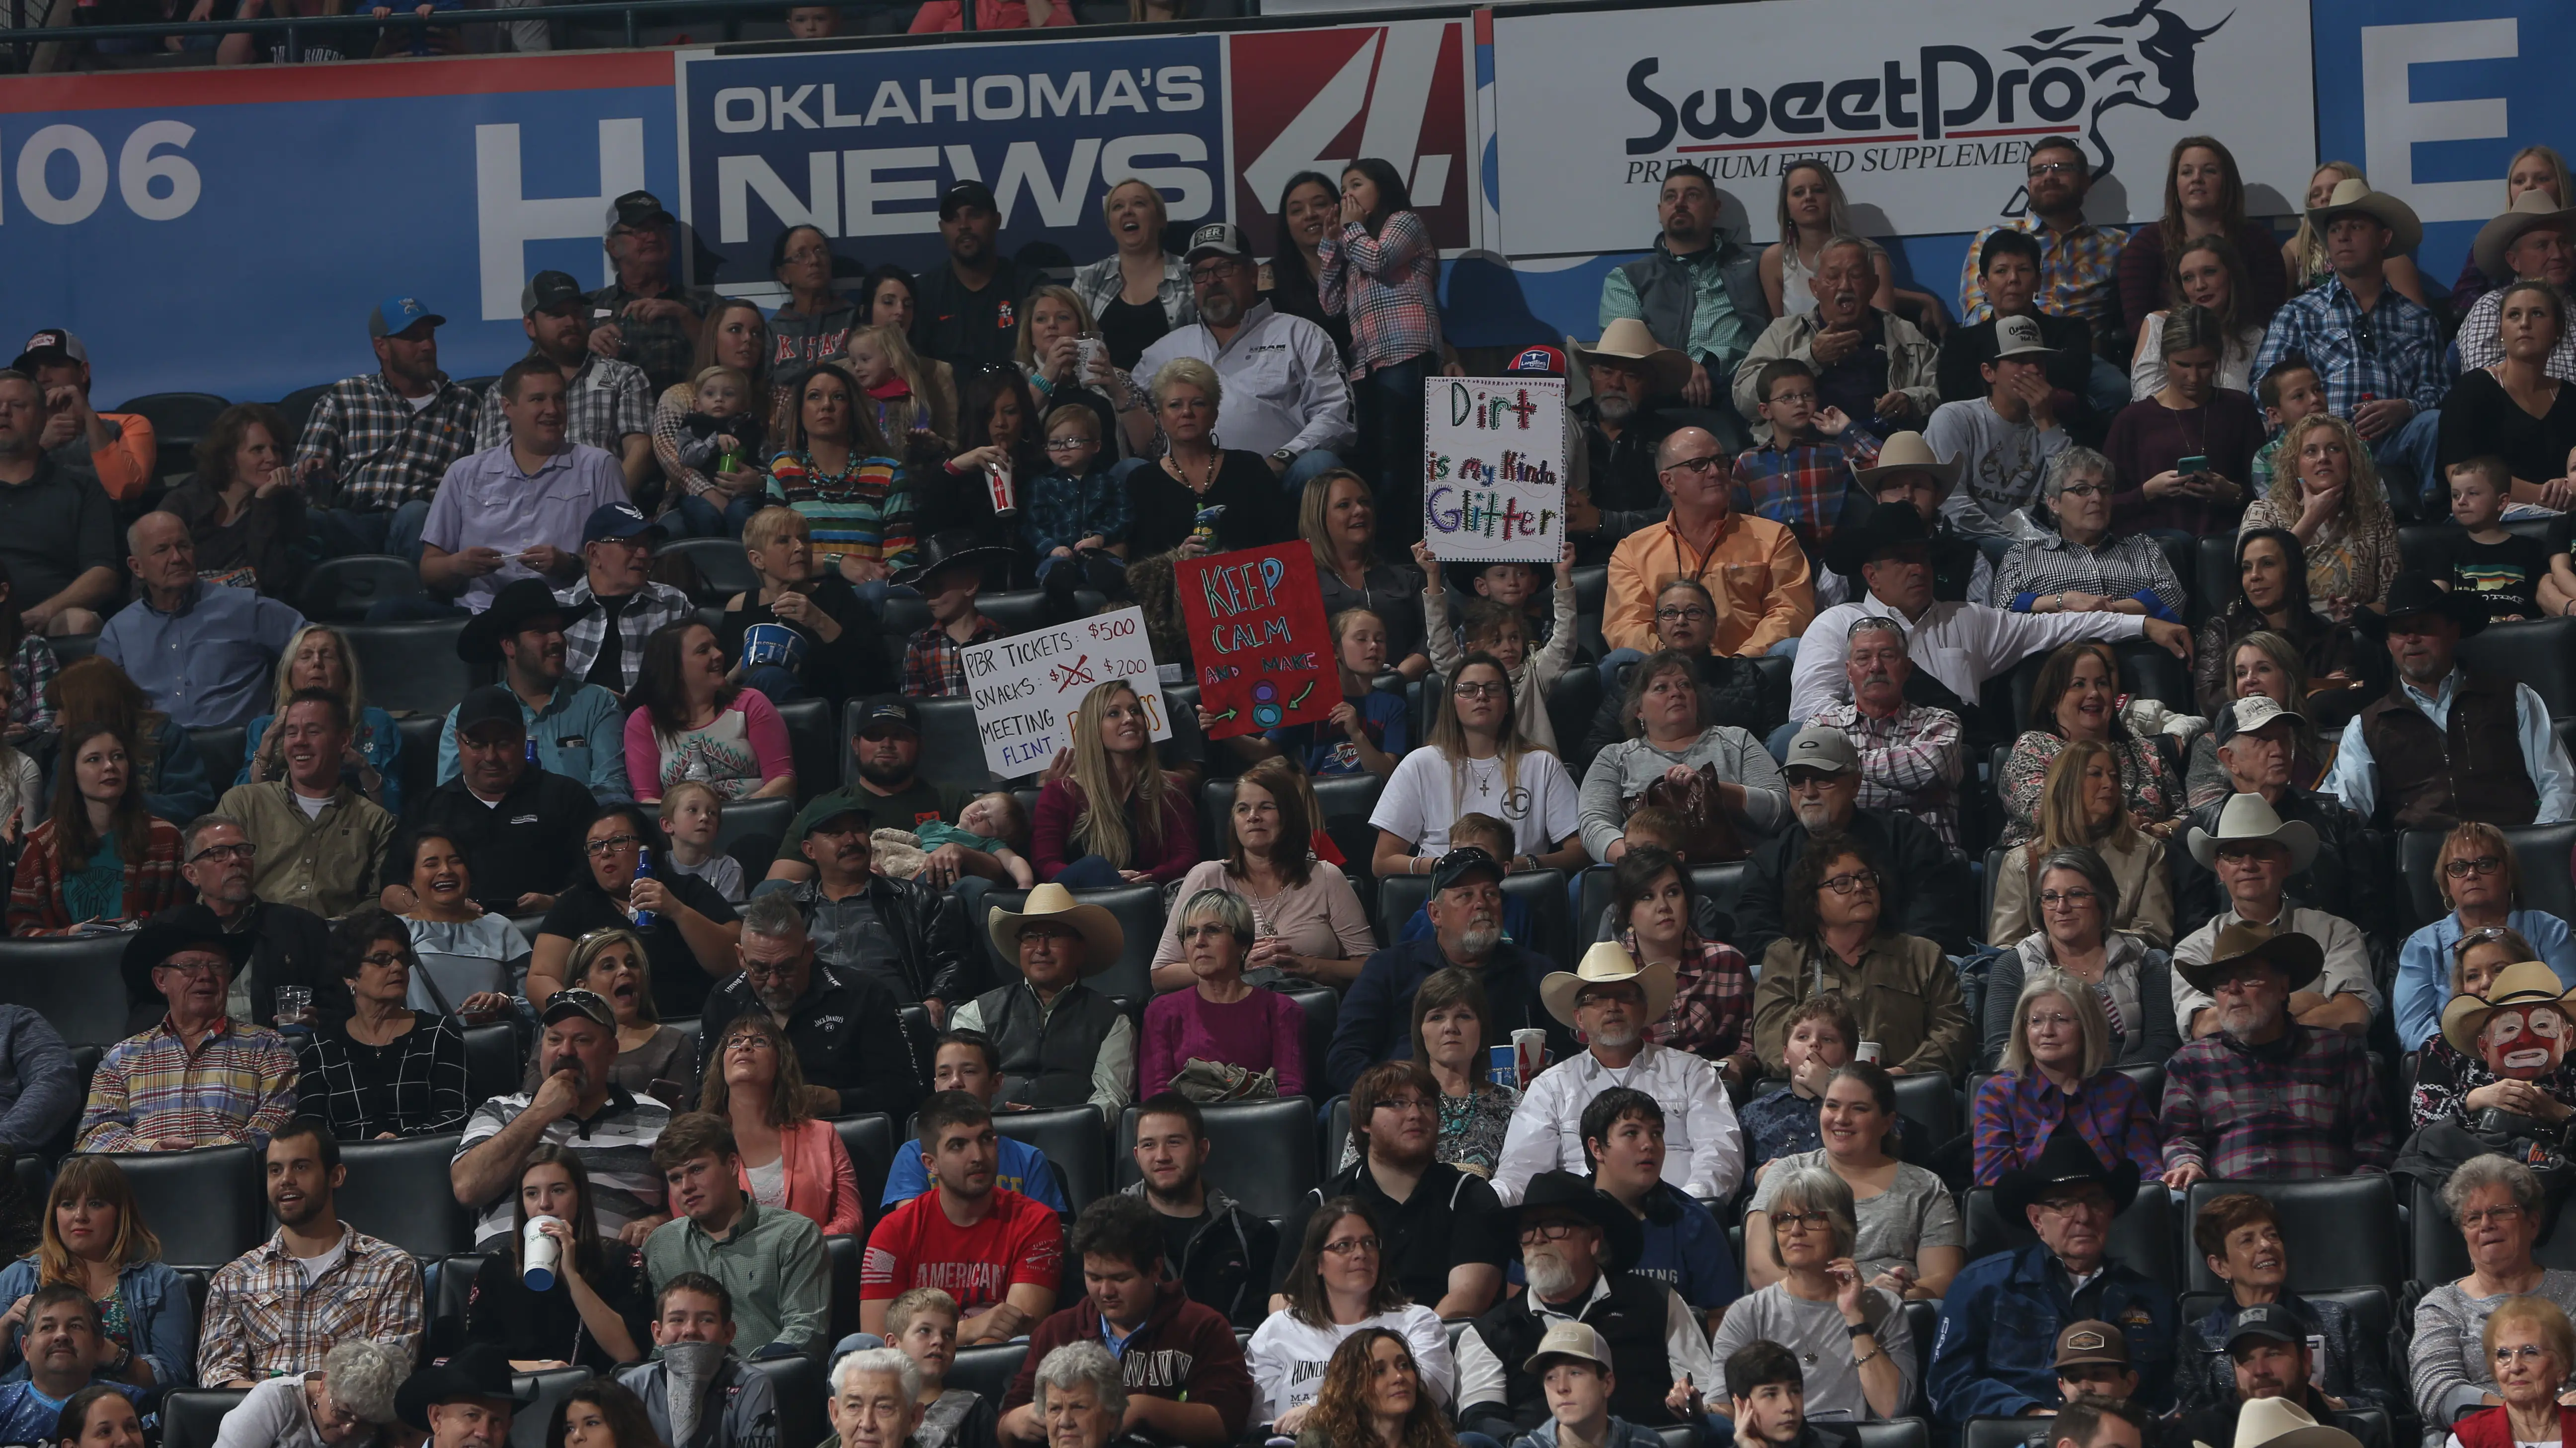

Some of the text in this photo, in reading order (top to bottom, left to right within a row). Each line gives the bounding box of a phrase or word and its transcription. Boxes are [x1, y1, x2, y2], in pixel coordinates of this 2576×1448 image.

[715, 66, 1205, 134] OKLAHOMA'S
[1626, 45, 2085, 155] SweetPro
[0, 120, 201, 226] 06
[718, 133, 1213, 243] NEWS
[1451, 382, 1537, 430] Dirt
[1429, 449, 1557, 487] is my Kinda
[1428, 484, 1557, 541] Glitter
[1201, 558, 1284, 618] KEEP
[966, 649, 998, 679] PBR
[1088, 618, 1135, 640] $500
[1212, 616, 1292, 654] CALM
[1103, 657, 1147, 678] $200
[1206, 652, 1318, 684] AND MAKE
[980, 709, 1054, 745] MEETING
[814, 1018, 826, 1027] JACK
[916, 1262, 1007, 1300] AMERICAN
[1123, 1349, 1193, 1388] NAVY
